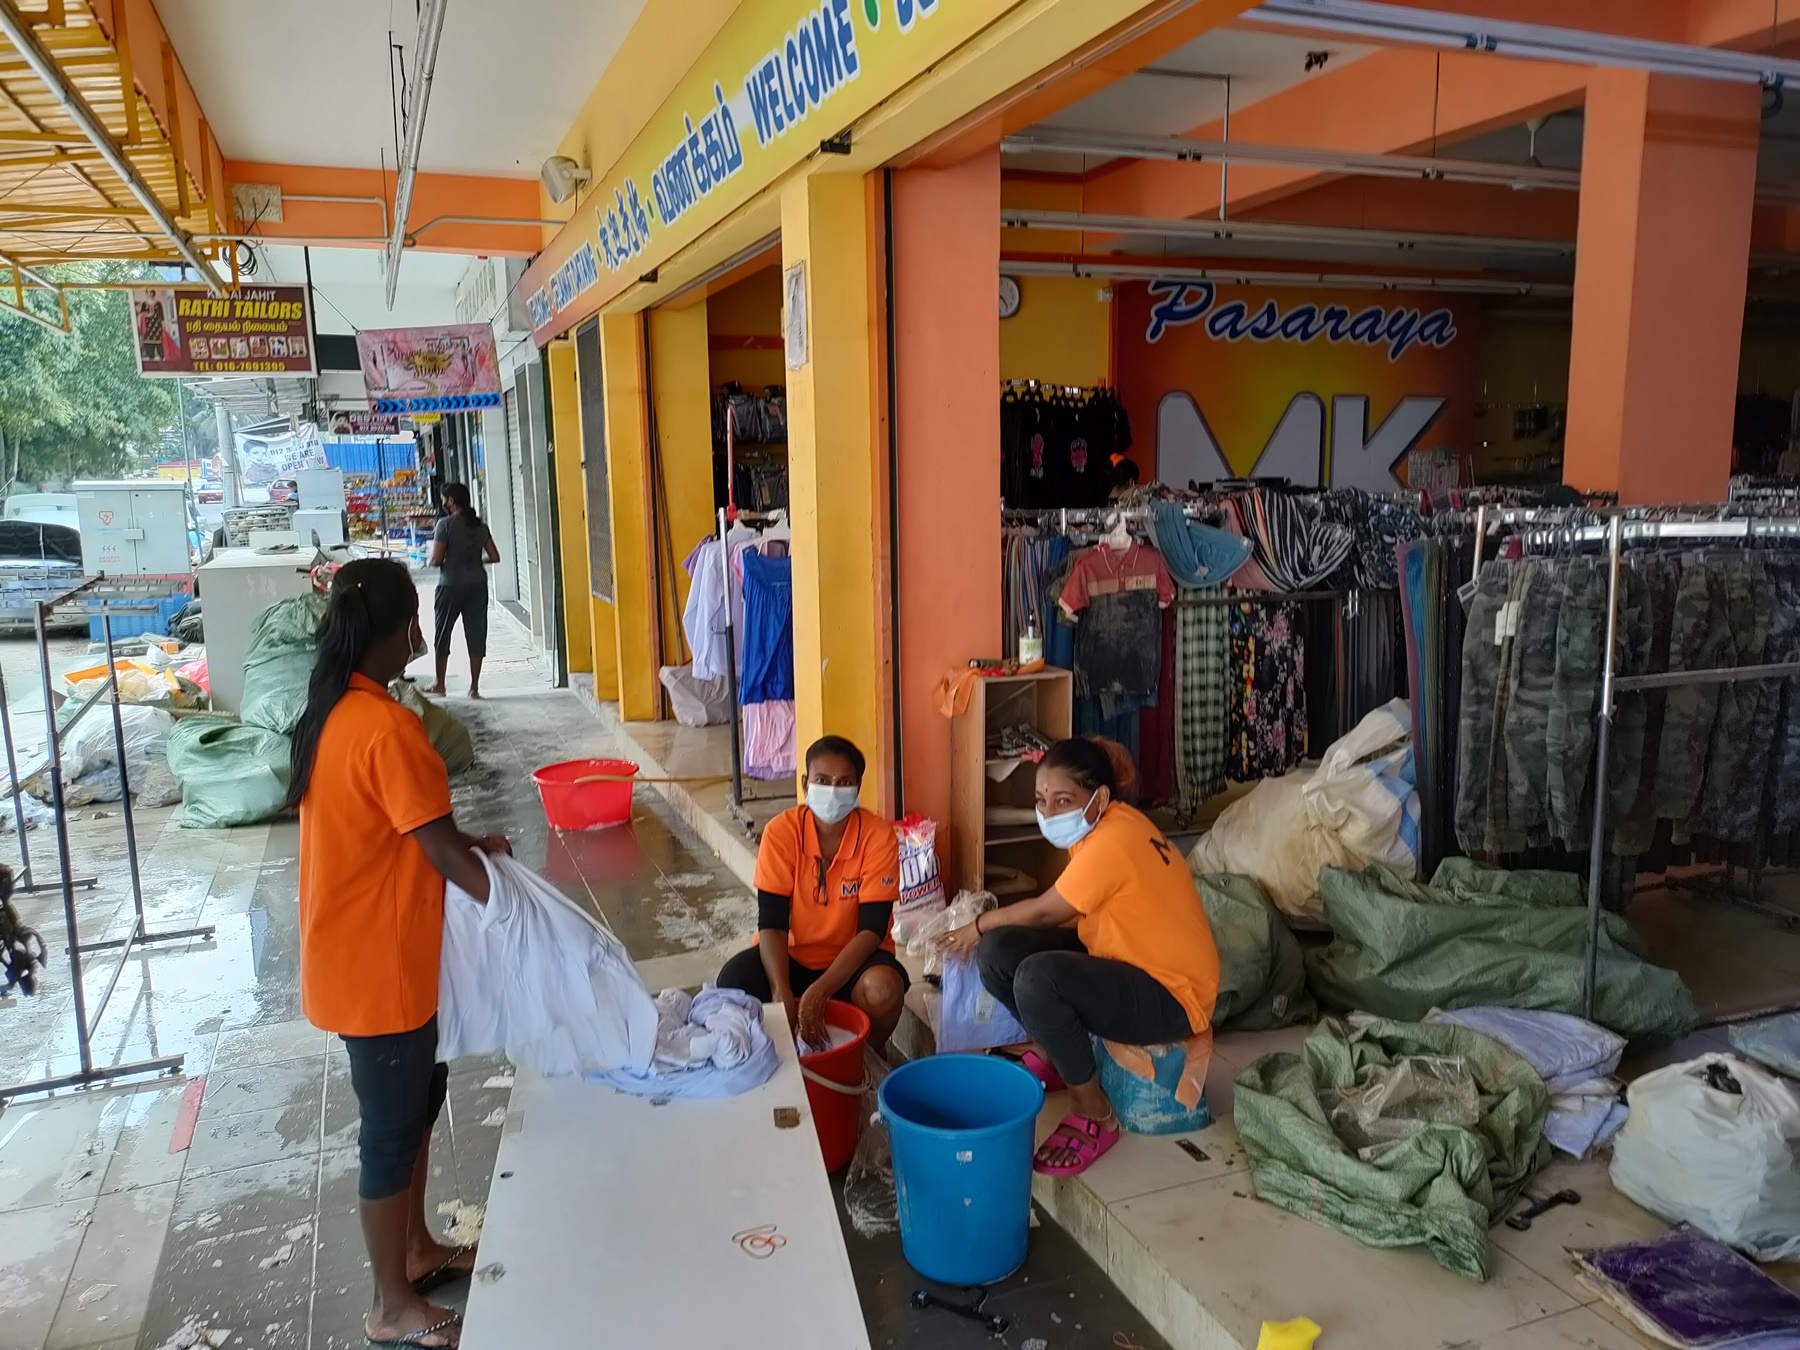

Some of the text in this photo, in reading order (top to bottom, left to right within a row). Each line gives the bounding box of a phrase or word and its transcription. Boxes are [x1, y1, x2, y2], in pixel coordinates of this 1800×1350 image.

[746, 0, 858, 145] WELCOME
[652, 84, 742, 224] வணக்கம்
[244, 290, 276, 301] JAHIT
[178, 298, 303, 320] RATHI TAILORS
[1147, 281, 1455, 361] Pasaraya
[192, 361, 214, 371] TEL:
[1158, 391, 1446, 490] MK
[281, 461, 304, 472] OPEN
[299, 449, 315, 459] ARE
[901, 877, 940, 905] POWER
